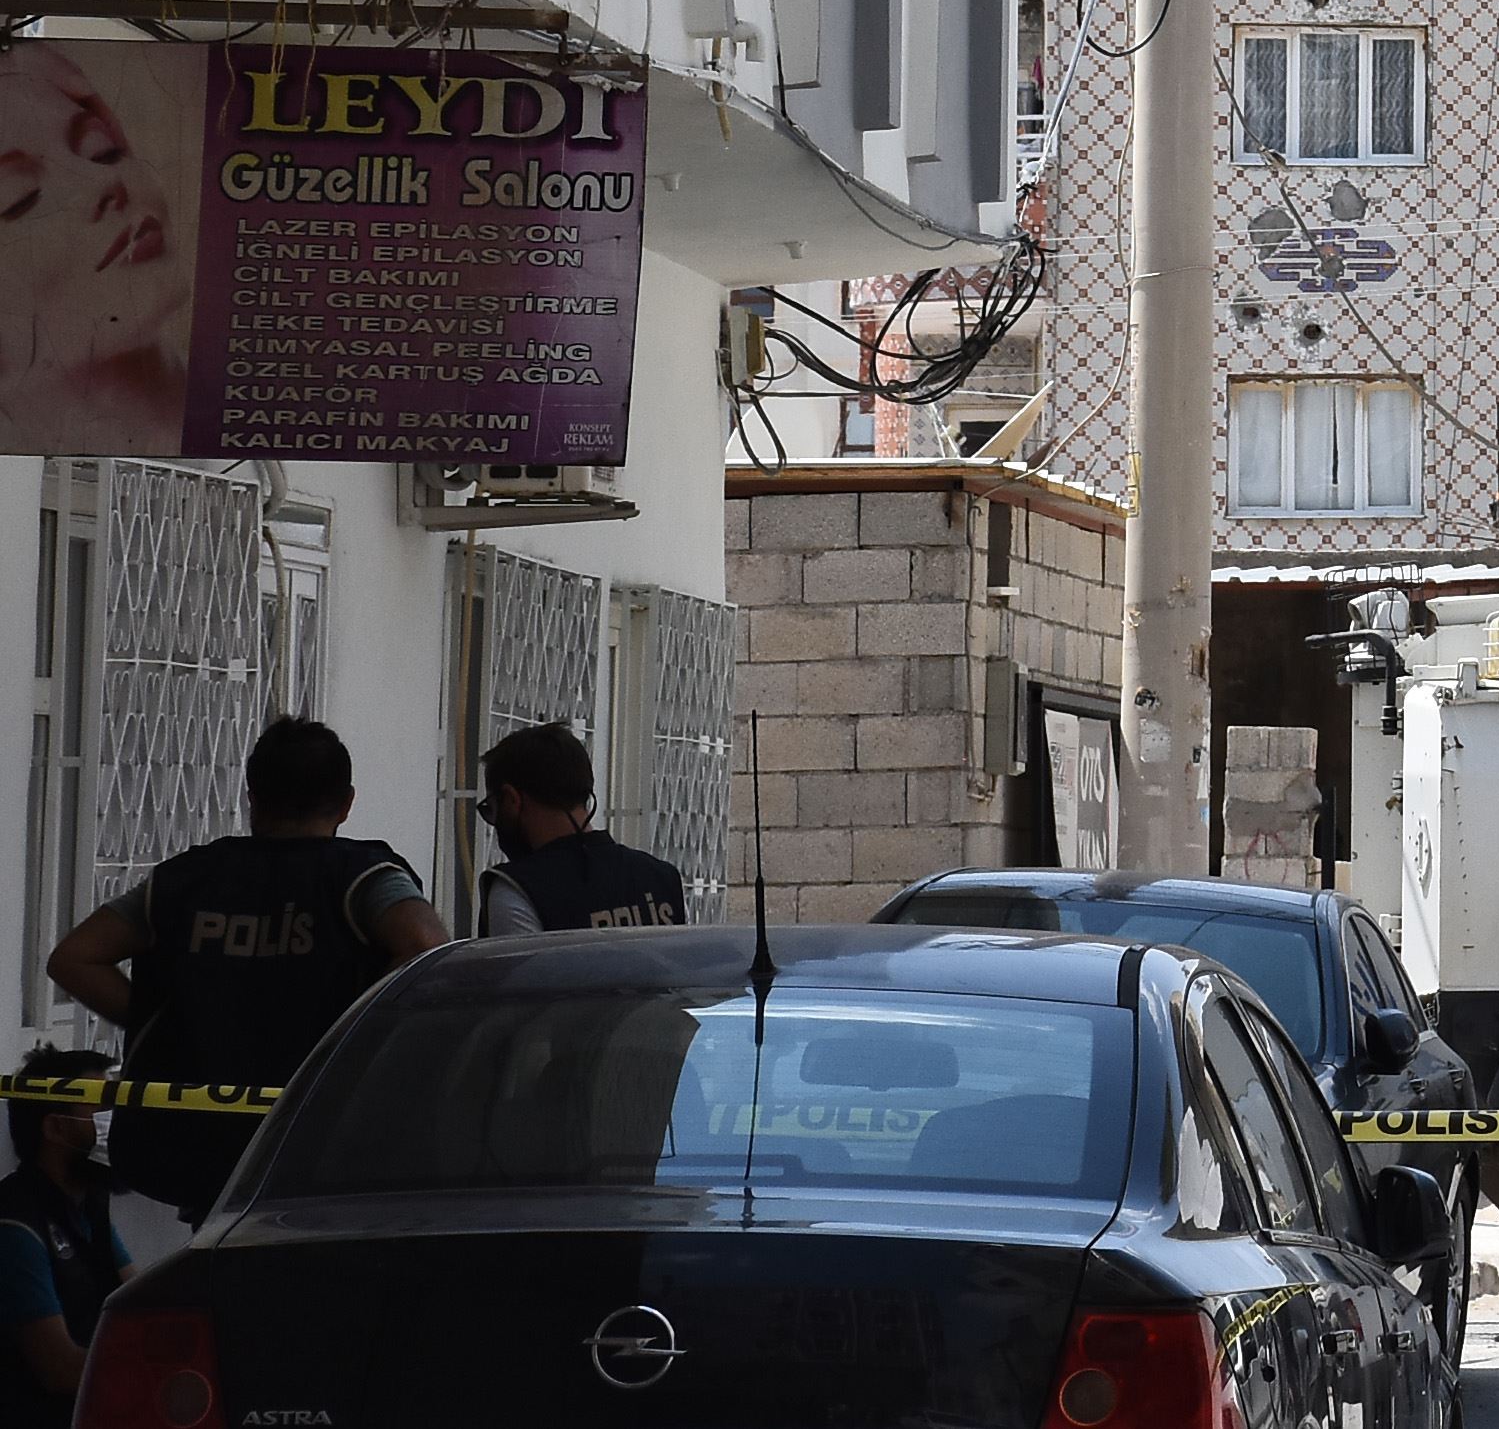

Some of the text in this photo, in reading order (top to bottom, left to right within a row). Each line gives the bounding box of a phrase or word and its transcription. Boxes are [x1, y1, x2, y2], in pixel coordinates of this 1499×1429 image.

[221, 153, 634, 211] Güzellik Salonu
[237, 219, 580, 243] LAZER EPİLASYON
[373, 243, 583, 267] EPİLASYON
[234, 262, 460, 287] CİLT BAKIMI
[232, 286, 315, 306] CİLT
[230, 314, 325, 331] LEKE
[228, 334, 592, 361] KİMYASAL PEELİNG
[226, 357, 602, 386] ÖZEL KARTUŞ AĞDA
[224, 383, 378, 403] KUAFÖR
[223, 407, 530, 431] PARAFİN BAKIMI
[221, 432, 509, 453] KALICI MAKYAJ
[563, 433, 614, 445] REKLAM
[241, 1410, 332, 1426] ASTRA
